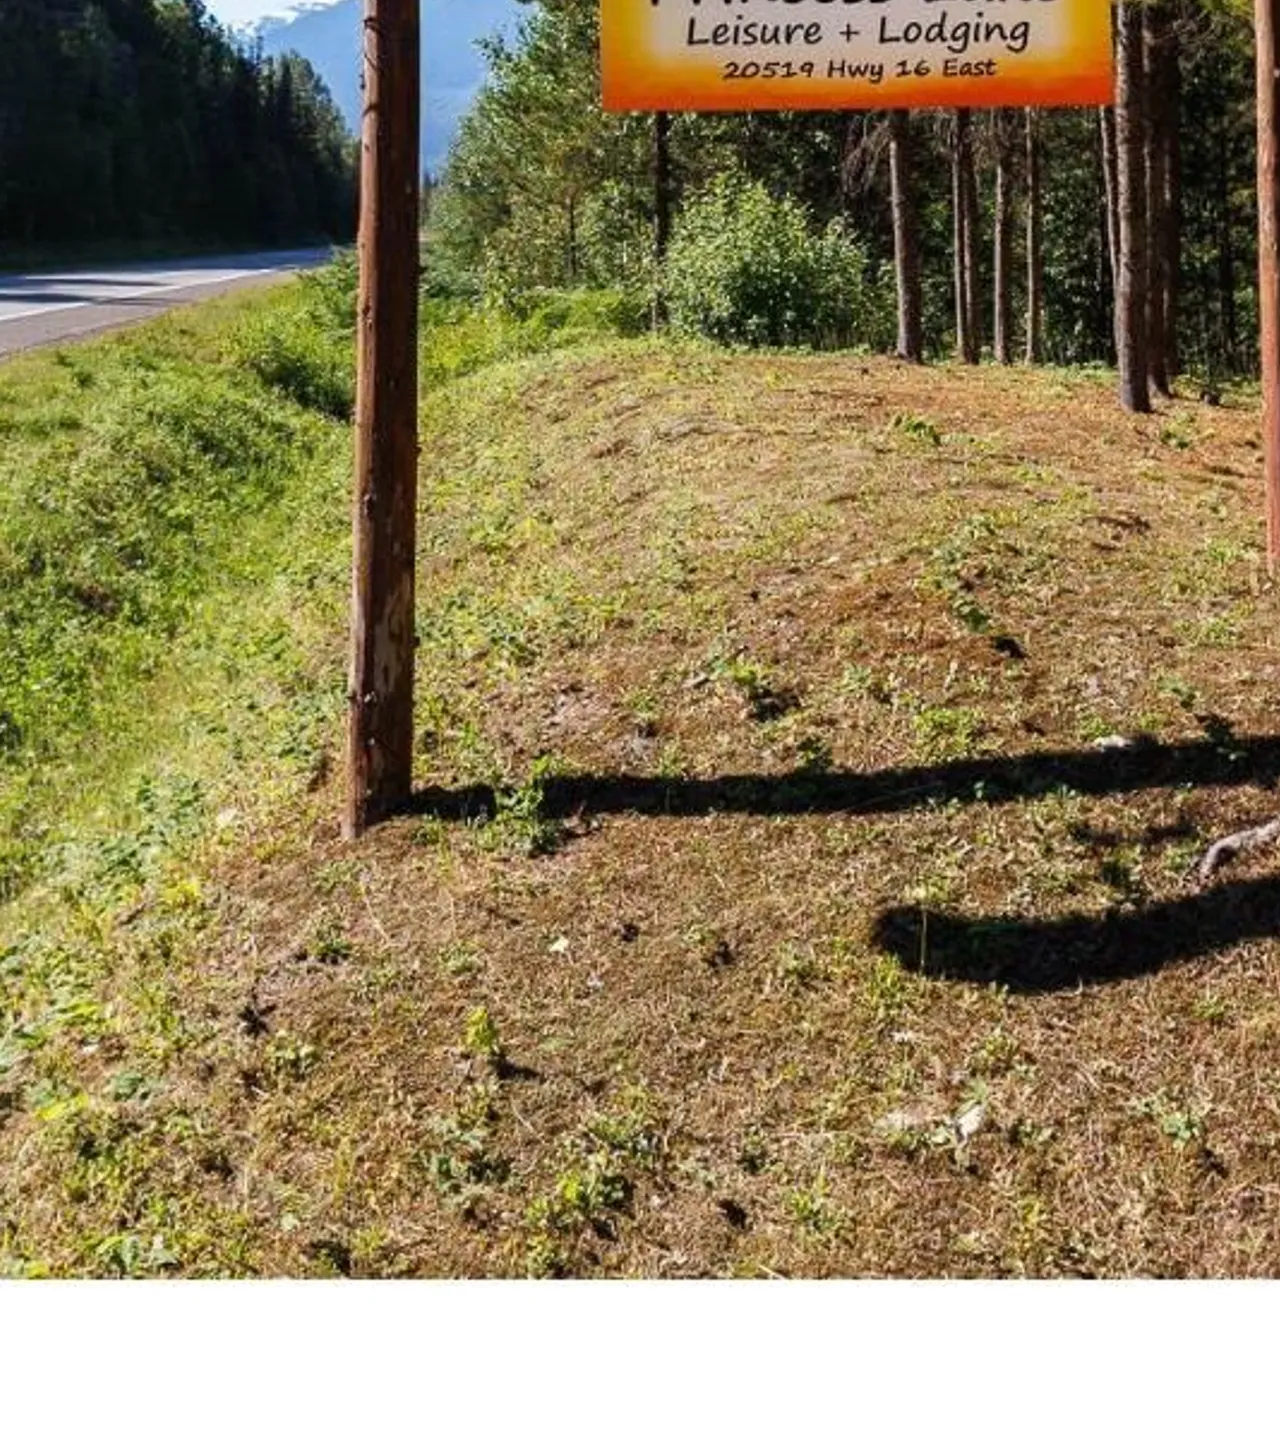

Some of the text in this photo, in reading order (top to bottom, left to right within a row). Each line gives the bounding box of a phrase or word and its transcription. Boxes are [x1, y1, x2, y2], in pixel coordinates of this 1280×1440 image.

[687, 12, 1030, 52] Leisure + Lodging
[723, 58, 996, 84] 20519 Hwy 16 East
